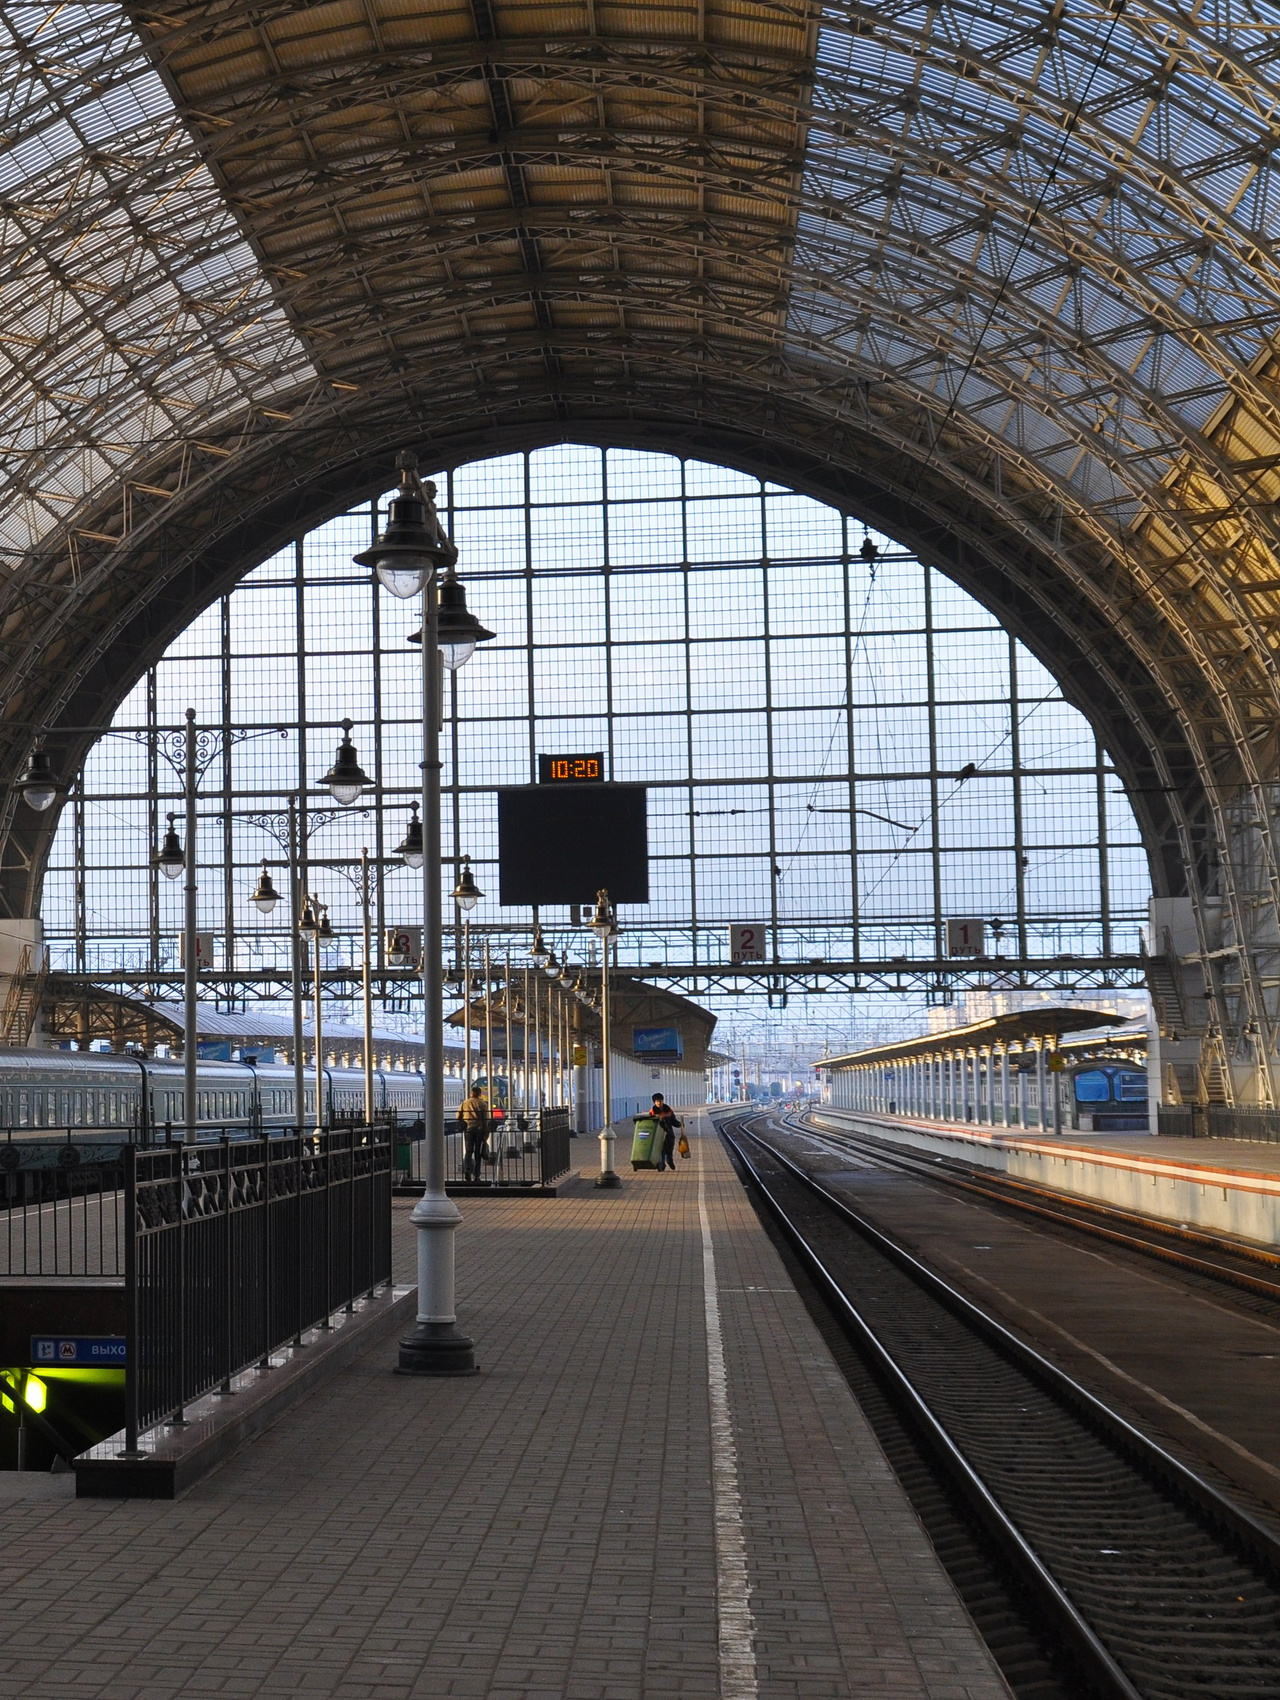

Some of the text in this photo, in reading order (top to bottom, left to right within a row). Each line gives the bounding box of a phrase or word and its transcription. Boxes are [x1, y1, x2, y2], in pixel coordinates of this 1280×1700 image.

[552, 760, 598, 778] 10:20
[740, 929, 755, 949] 2
[959, 924, 969, 944] 1
[399, 934, 410, 953] 3
[951, 946, 982, 955] ПУТЬ
[733, 951, 763, 959] ПУТЬ
[91, 1345, 127, 1355] ВЫХО
